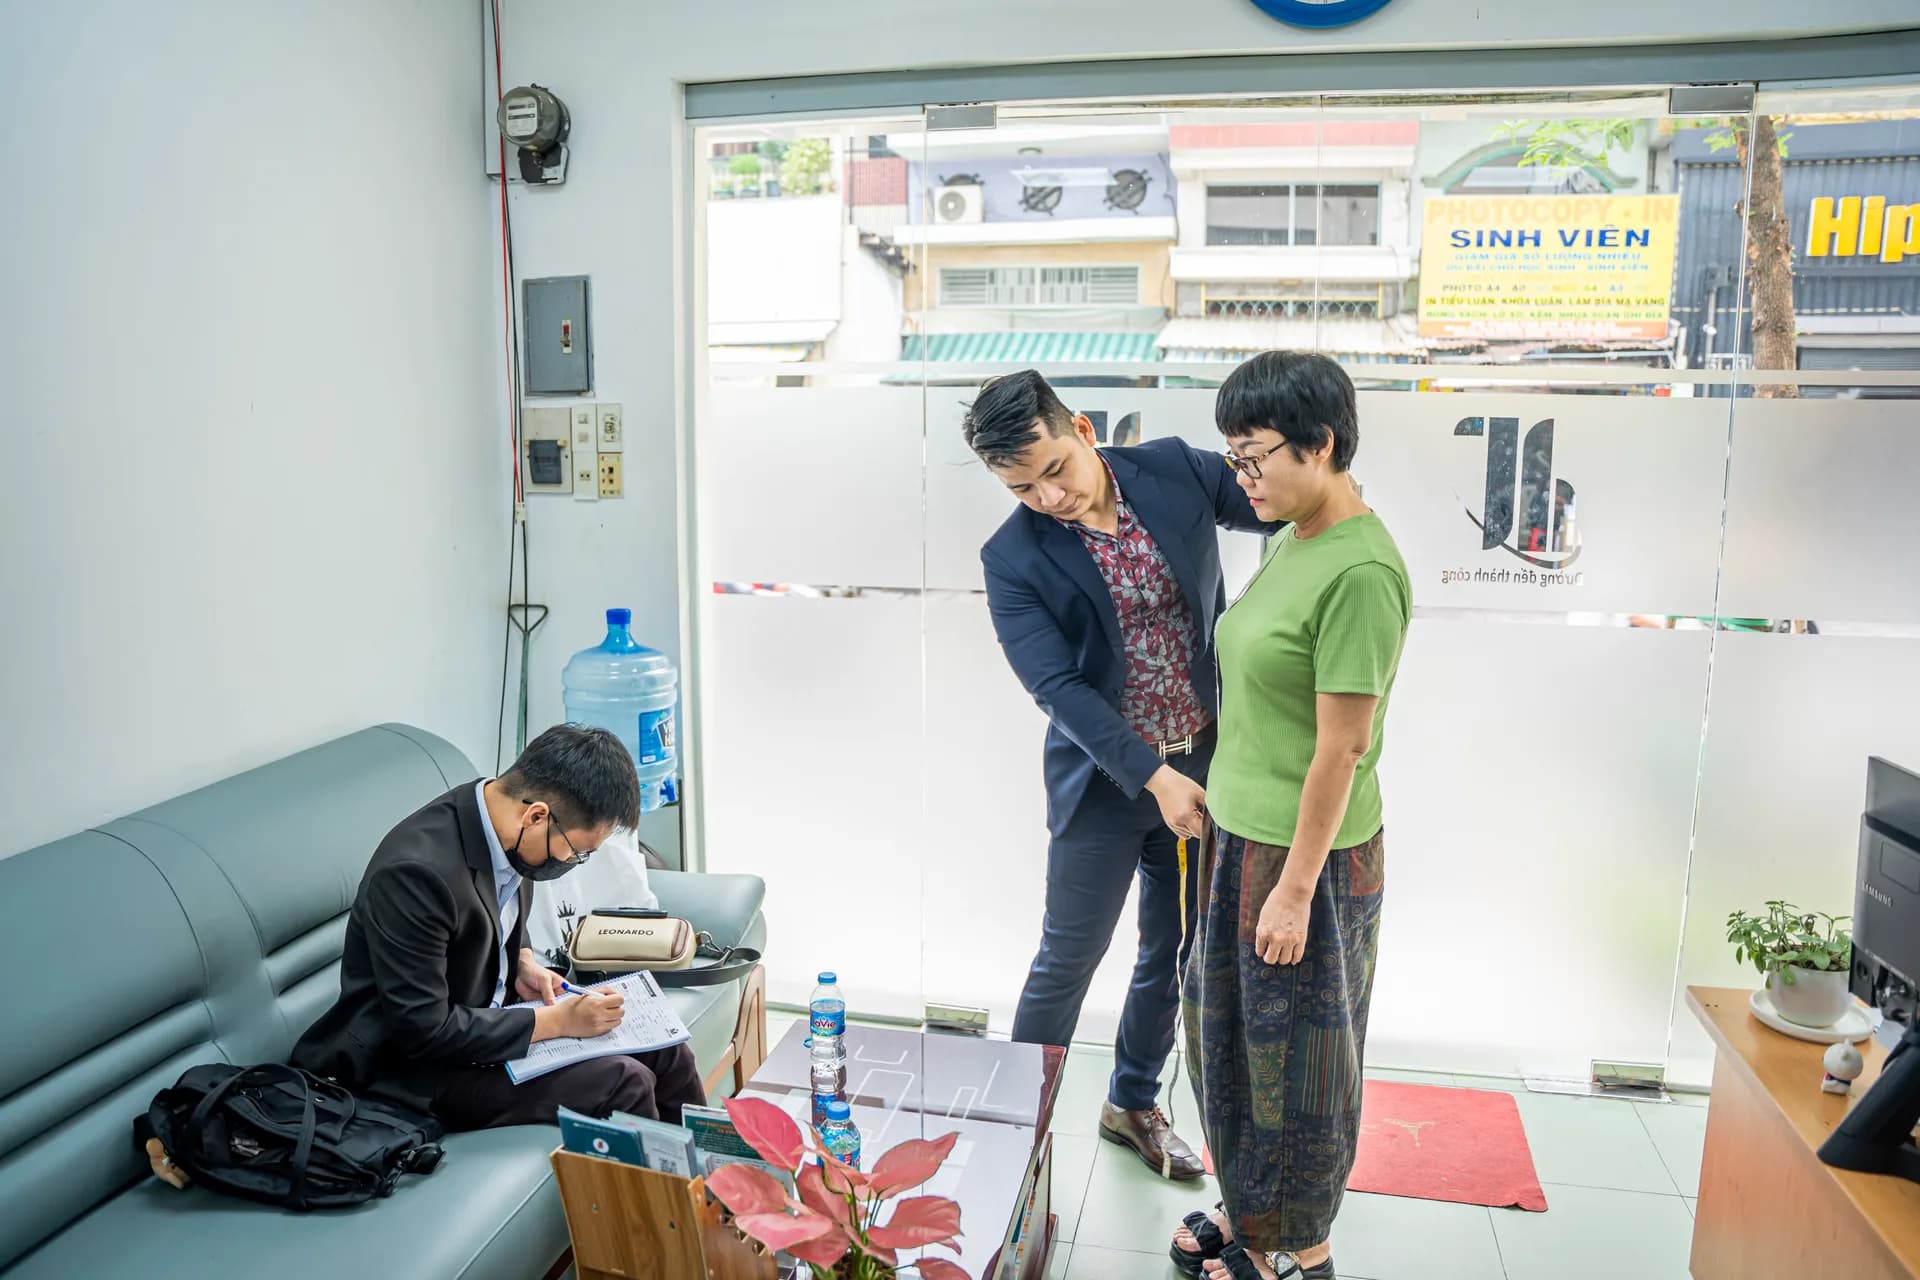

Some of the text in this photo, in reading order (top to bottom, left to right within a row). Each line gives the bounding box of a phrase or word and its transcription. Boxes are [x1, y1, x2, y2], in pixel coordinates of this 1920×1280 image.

[1428, 199, 1613, 223] PHOTOCOPY
[1643, 198, 1674, 222] IN
[1450, 224, 1650, 248] SINH VIÊN
[1806, 195, 1920, 263] Hip
[1442, 284, 1482, 292] PHOTO
[1862, 881, 1892, 908] SAMSUNG
[814, 1019, 836, 1028] aVie
